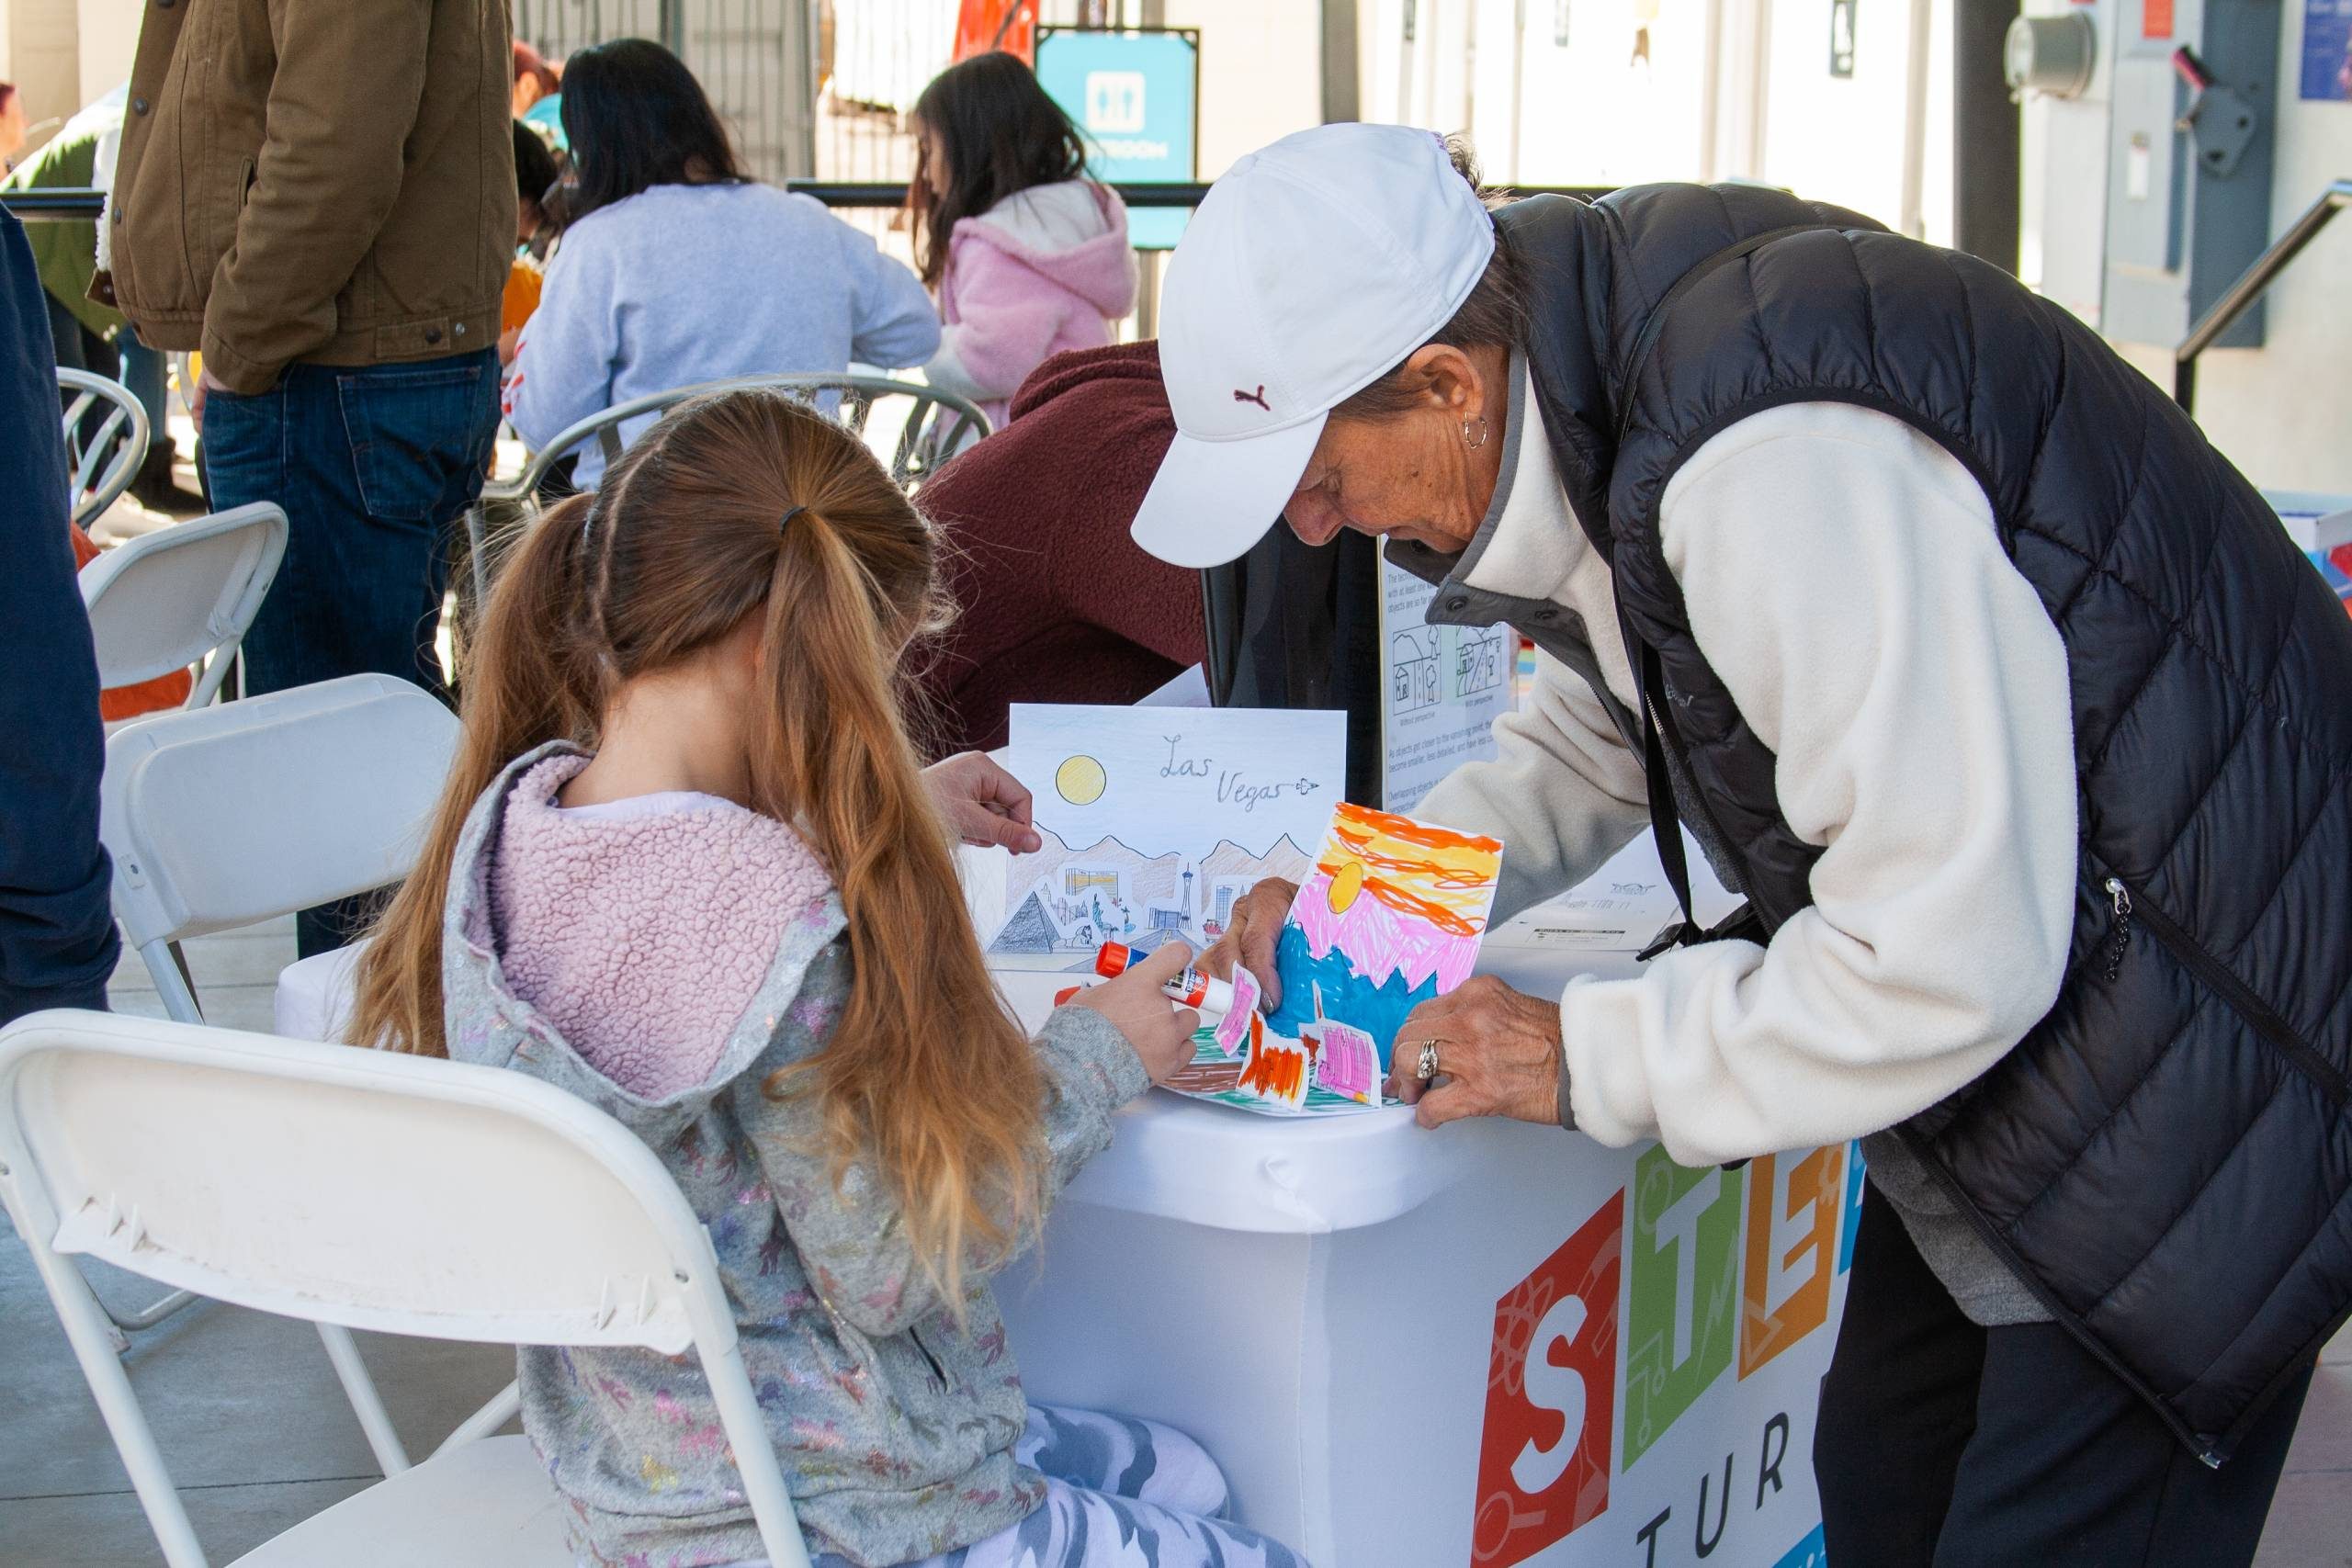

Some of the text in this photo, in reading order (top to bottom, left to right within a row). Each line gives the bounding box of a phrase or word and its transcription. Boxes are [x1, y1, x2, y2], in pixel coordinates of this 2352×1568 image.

[1159, 734, 1213, 779] Las
[1217, 770, 1286, 813] Vegas
[1510, 1142, 1866, 1495] STE
